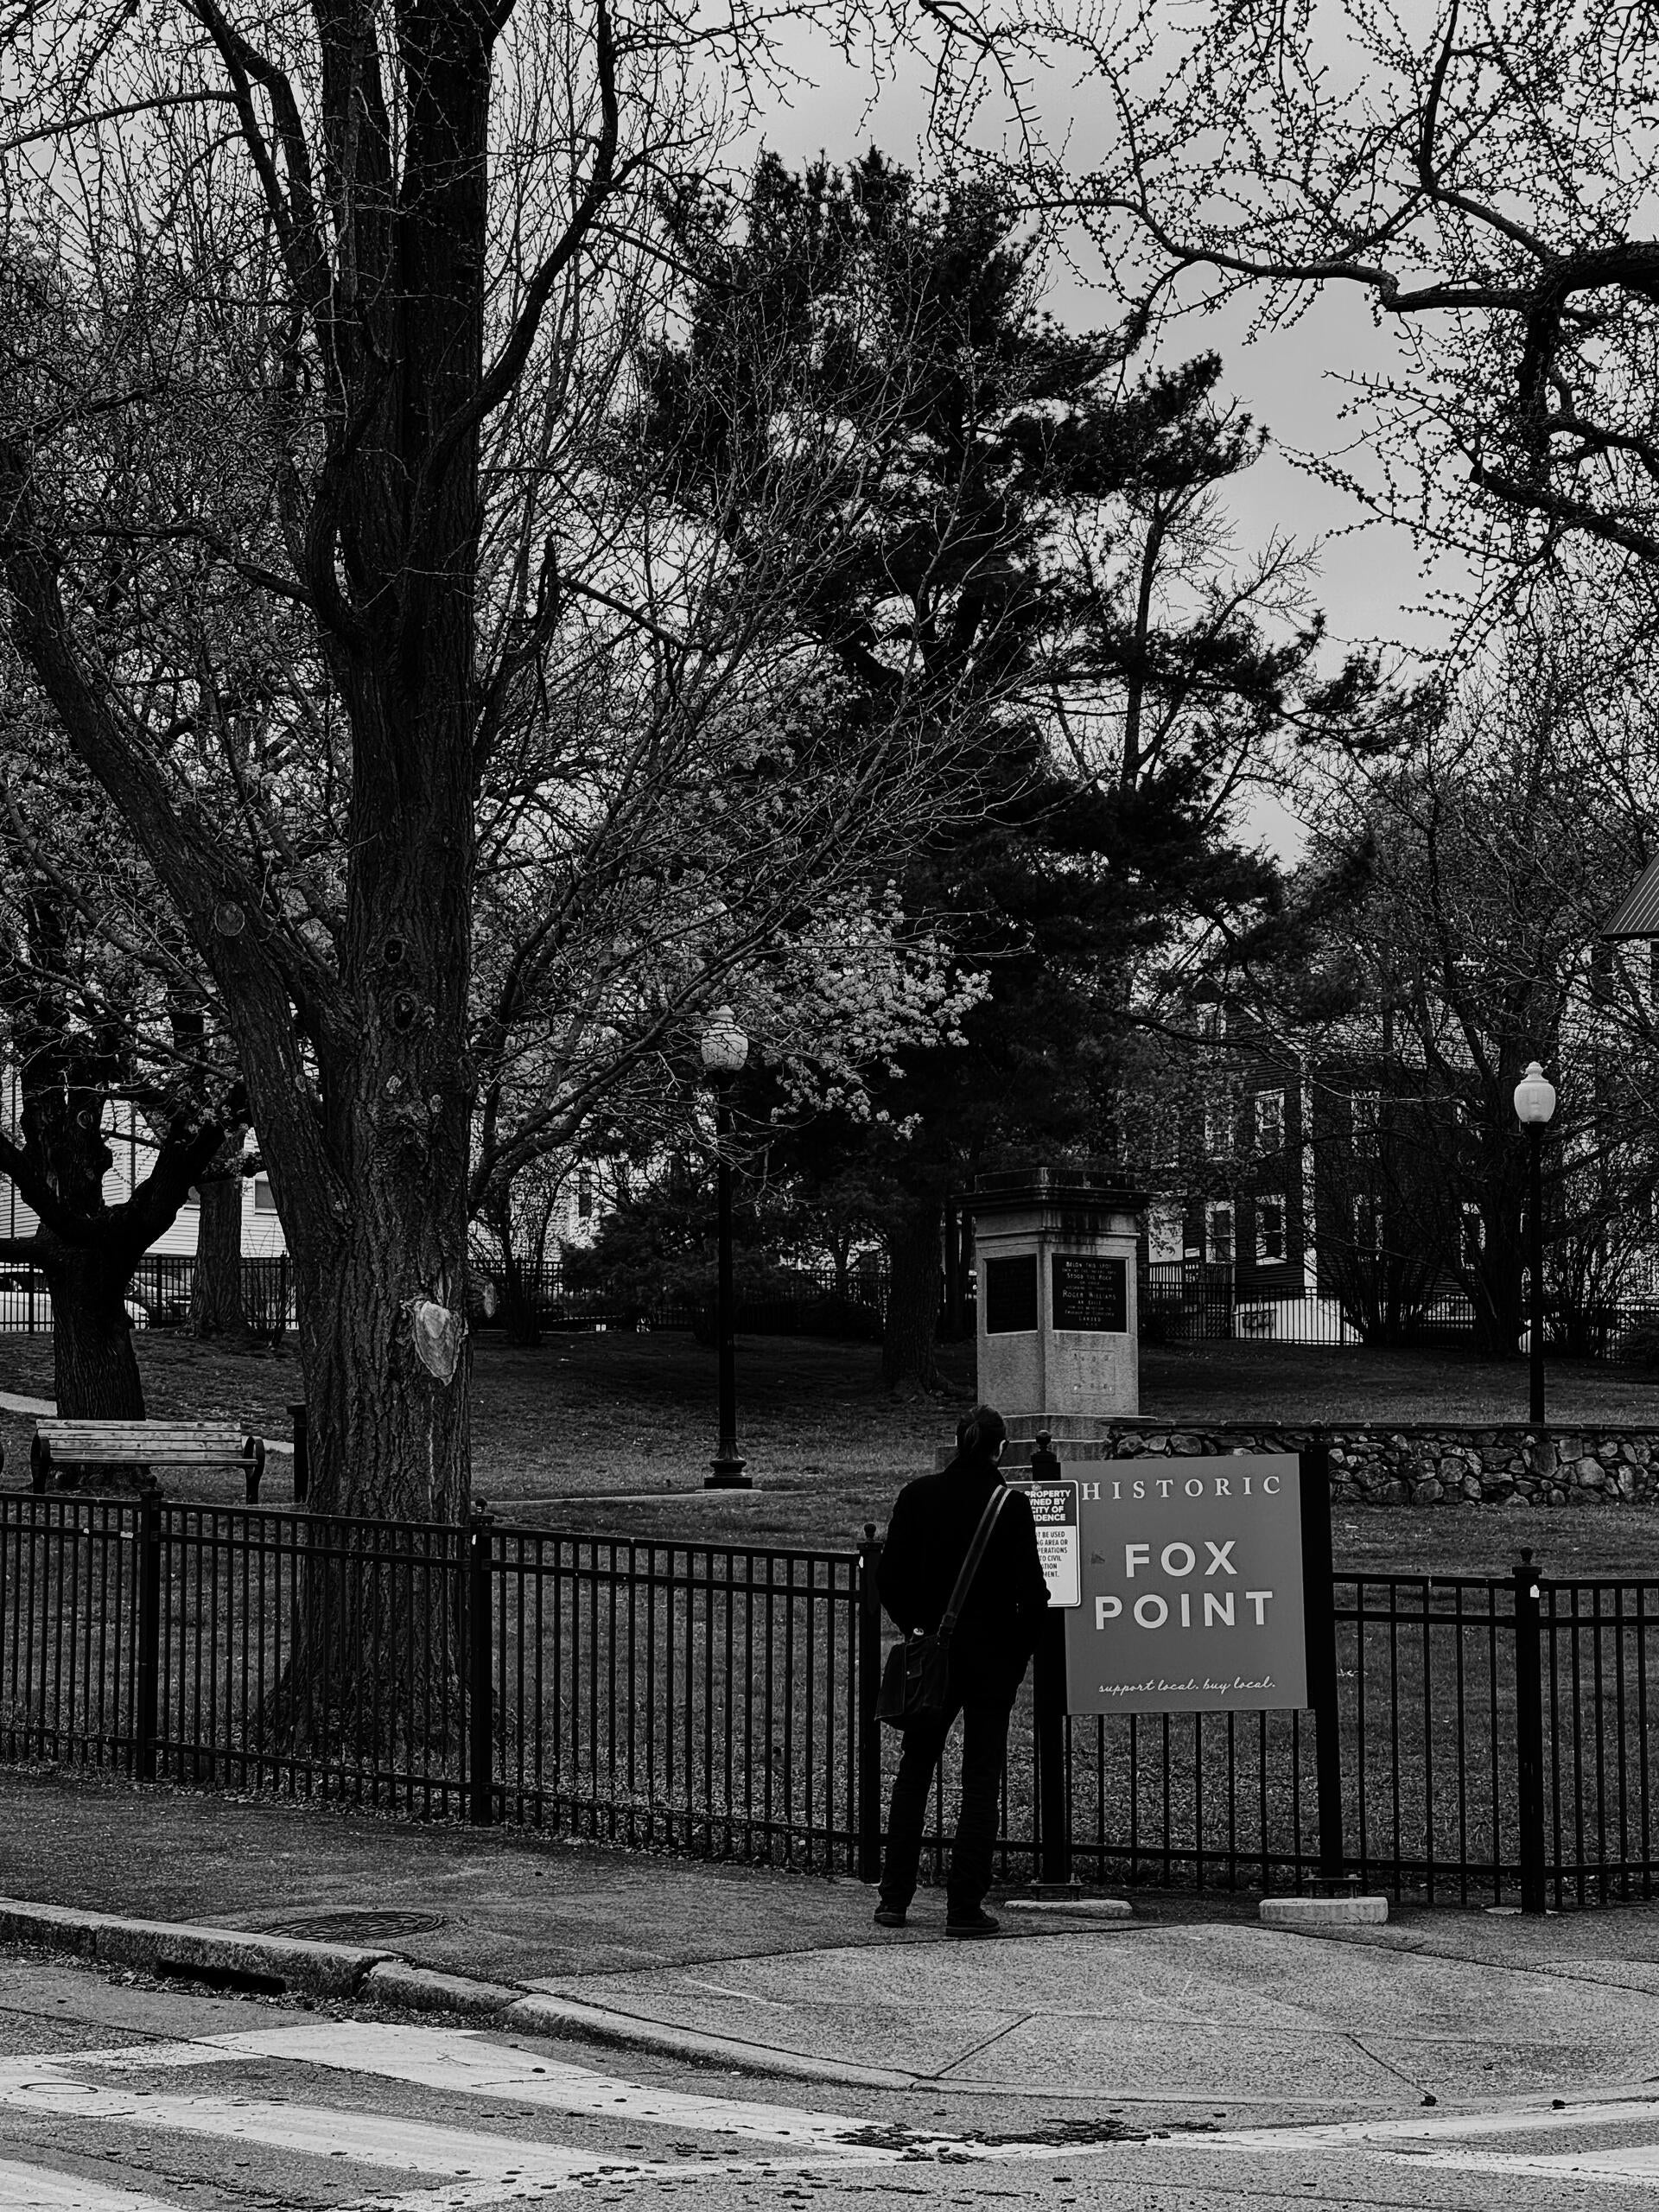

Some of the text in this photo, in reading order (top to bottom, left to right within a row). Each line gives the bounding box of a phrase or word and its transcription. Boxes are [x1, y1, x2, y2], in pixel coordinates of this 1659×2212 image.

[1082, 1476, 1281, 1501] HISTORIC
[1033, 1513, 1066, 1522] IDENCE
[1051, 1505, 1065, 1514] OF
[1125, 1541, 1238, 1579] FOX
[1095, 1590, 1274, 1630] POINT
[1098, 1675, 1276, 1696] support local. buy local.
